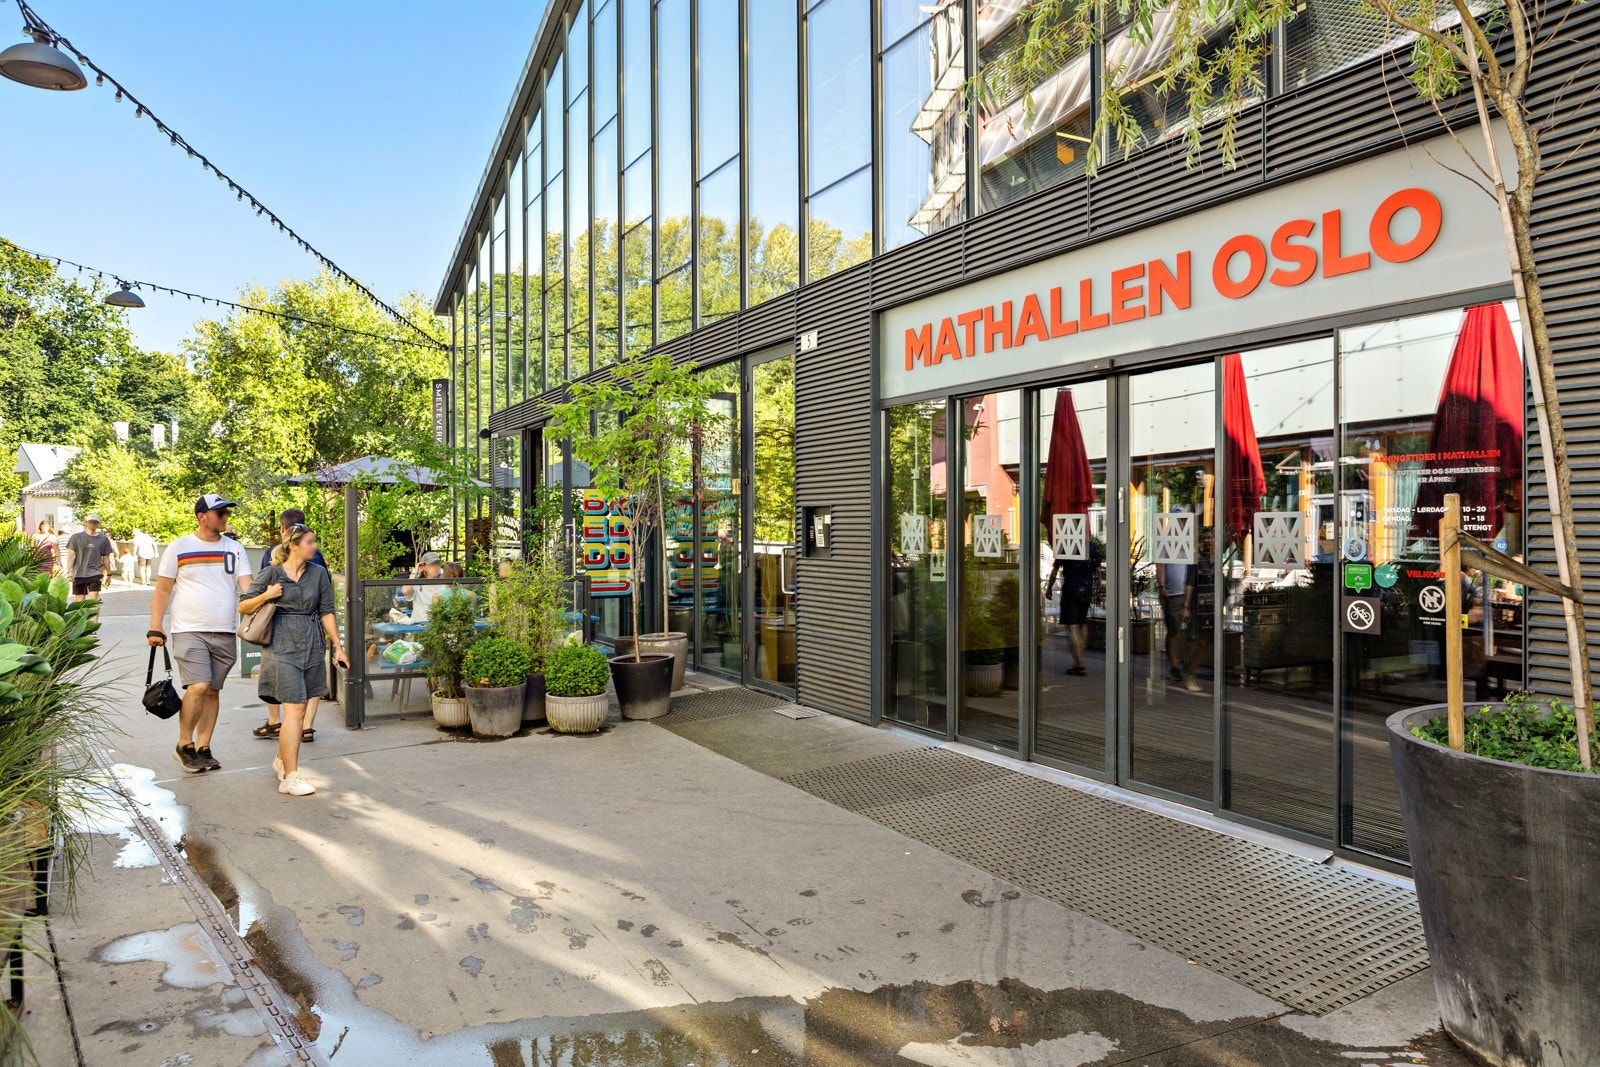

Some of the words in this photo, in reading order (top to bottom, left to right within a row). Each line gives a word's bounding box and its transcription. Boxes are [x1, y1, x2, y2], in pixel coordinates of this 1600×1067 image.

[905, 251, 1191, 371] MATHALLEN
[1212, 188, 1443, 299] OSLO
[435, 383, 443, 447] SMELTEVERK
[1443, 450, 1500, 460] MATHALLEN
[1444, 466, 1496, 475] SPISESTEDER
